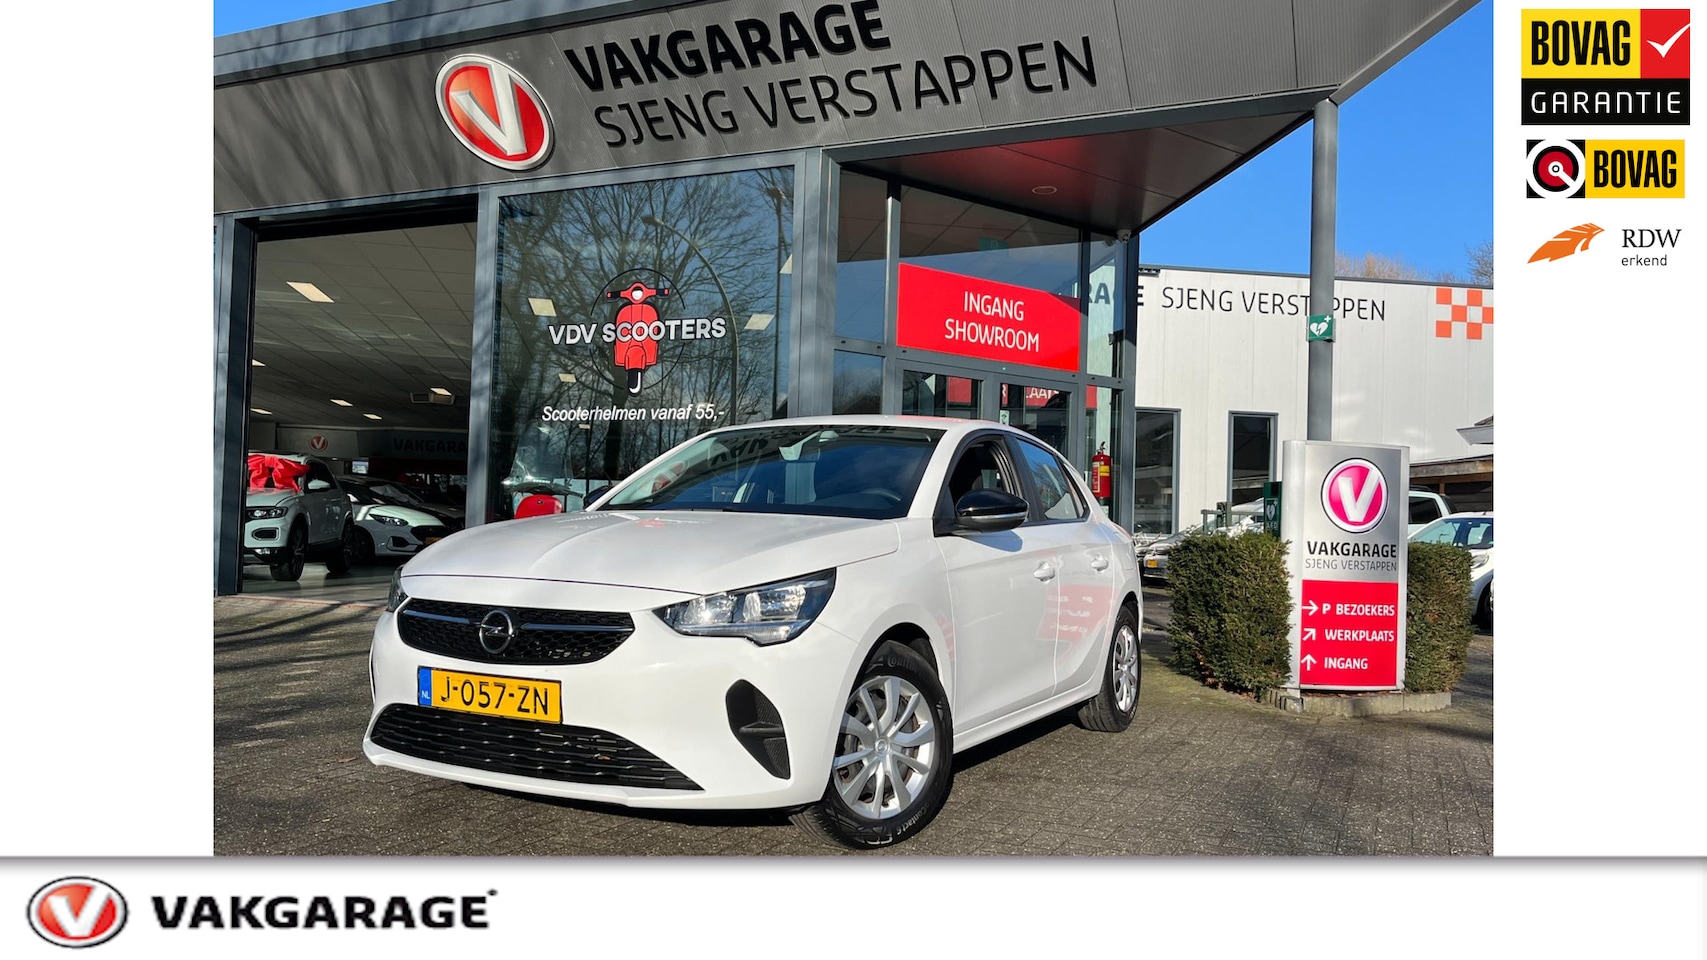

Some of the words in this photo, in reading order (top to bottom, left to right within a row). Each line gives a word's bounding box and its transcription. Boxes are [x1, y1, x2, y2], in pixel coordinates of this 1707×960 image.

[564, 0, 891, 92] VAKGARAGE
[592, 89, 739, 148] SJENG
[743, 34, 1100, 128] VERSTAPPEN
[964, 291, 1024, 322] INGANG
[1162, 286, 1233, 312] SJENG
[1241, 291, 1386, 322] VERSTPPEN
[548, 323, 597, 346] VDV
[602, 317, 727, 343] SCOOTERS
[944, 318, 1040, 353] SHOWROOM
[541, 405, 646, 421] Scooterhelmen
[651, 404, 692, 421] vanaf
[695, 404, 725, 422] 55,-
[1307, 541, 1397, 558] VAKGARAGE
[1305, 558, 1338, 570] SJENG
[1341, 559, 1397, 572] VERSTAPPEN
[1322, 603, 1331, 615] P
[1336, 603, 1395, 616] BEZOEKERS
[1325, 628, 1395, 642] WERKPLAATS
[1324, 657, 1368, 670] INGANG
[421, 689, 431, 699] NL
[441, 675, 549, 716] J-057-ZN
